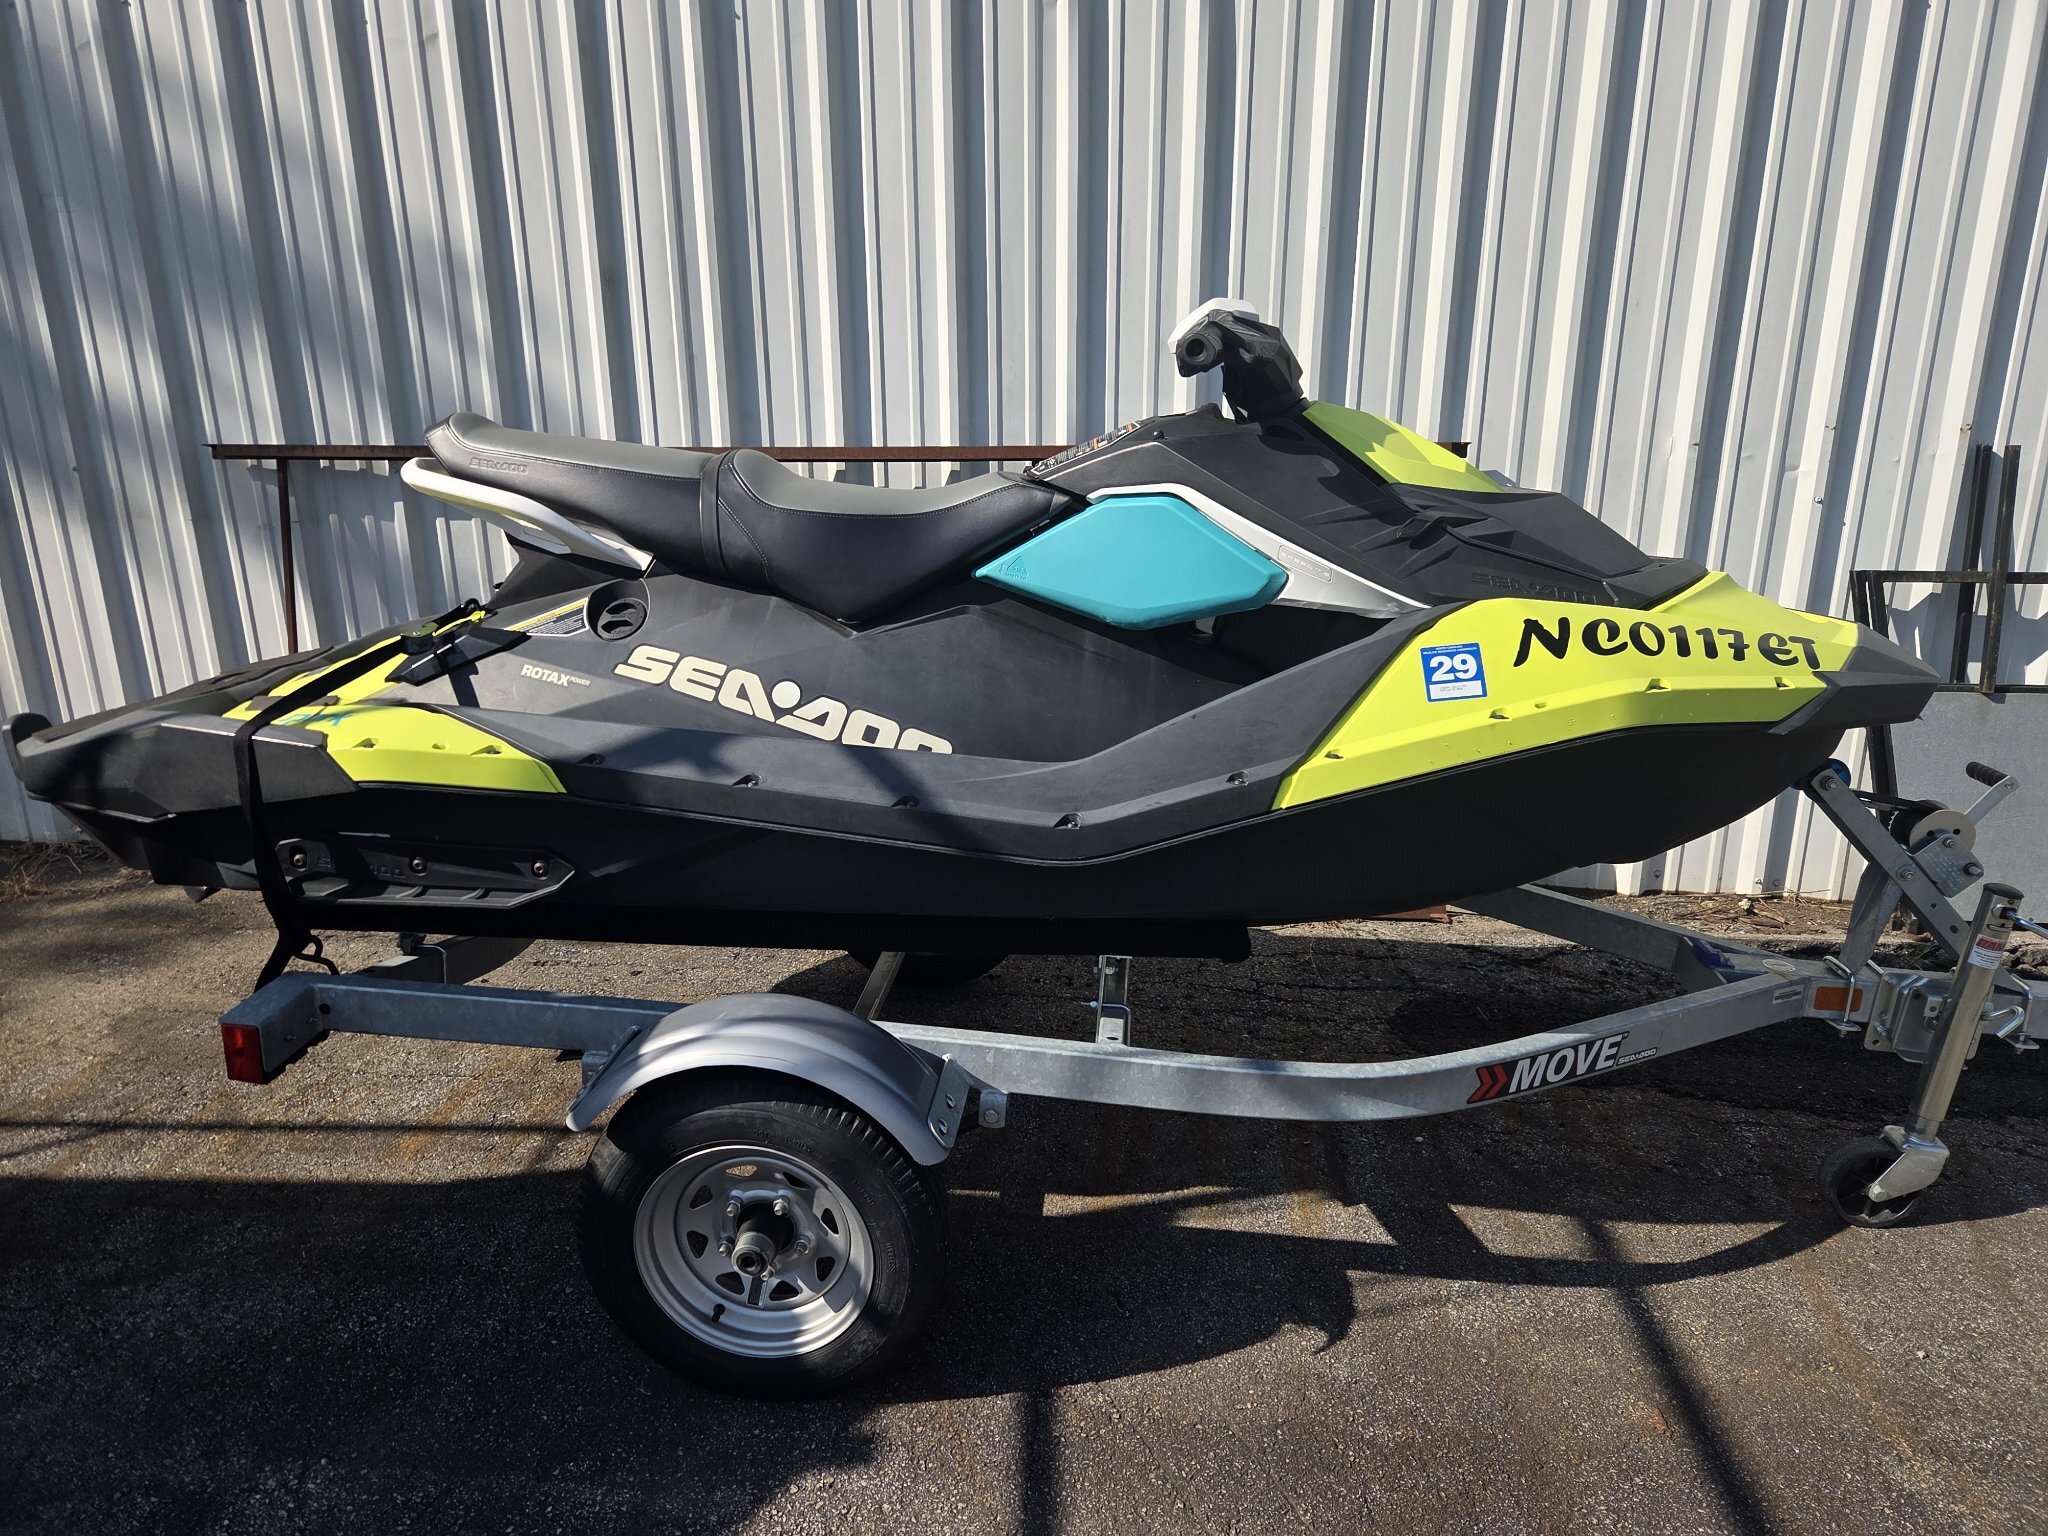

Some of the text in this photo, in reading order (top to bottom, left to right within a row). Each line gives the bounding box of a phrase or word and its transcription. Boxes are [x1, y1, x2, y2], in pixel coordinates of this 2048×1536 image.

[520, 664, 570, 686] ROTAX
[1430, 653, 1477, 682] 29
[1509, 1034, 1622, 1093] MOVE
